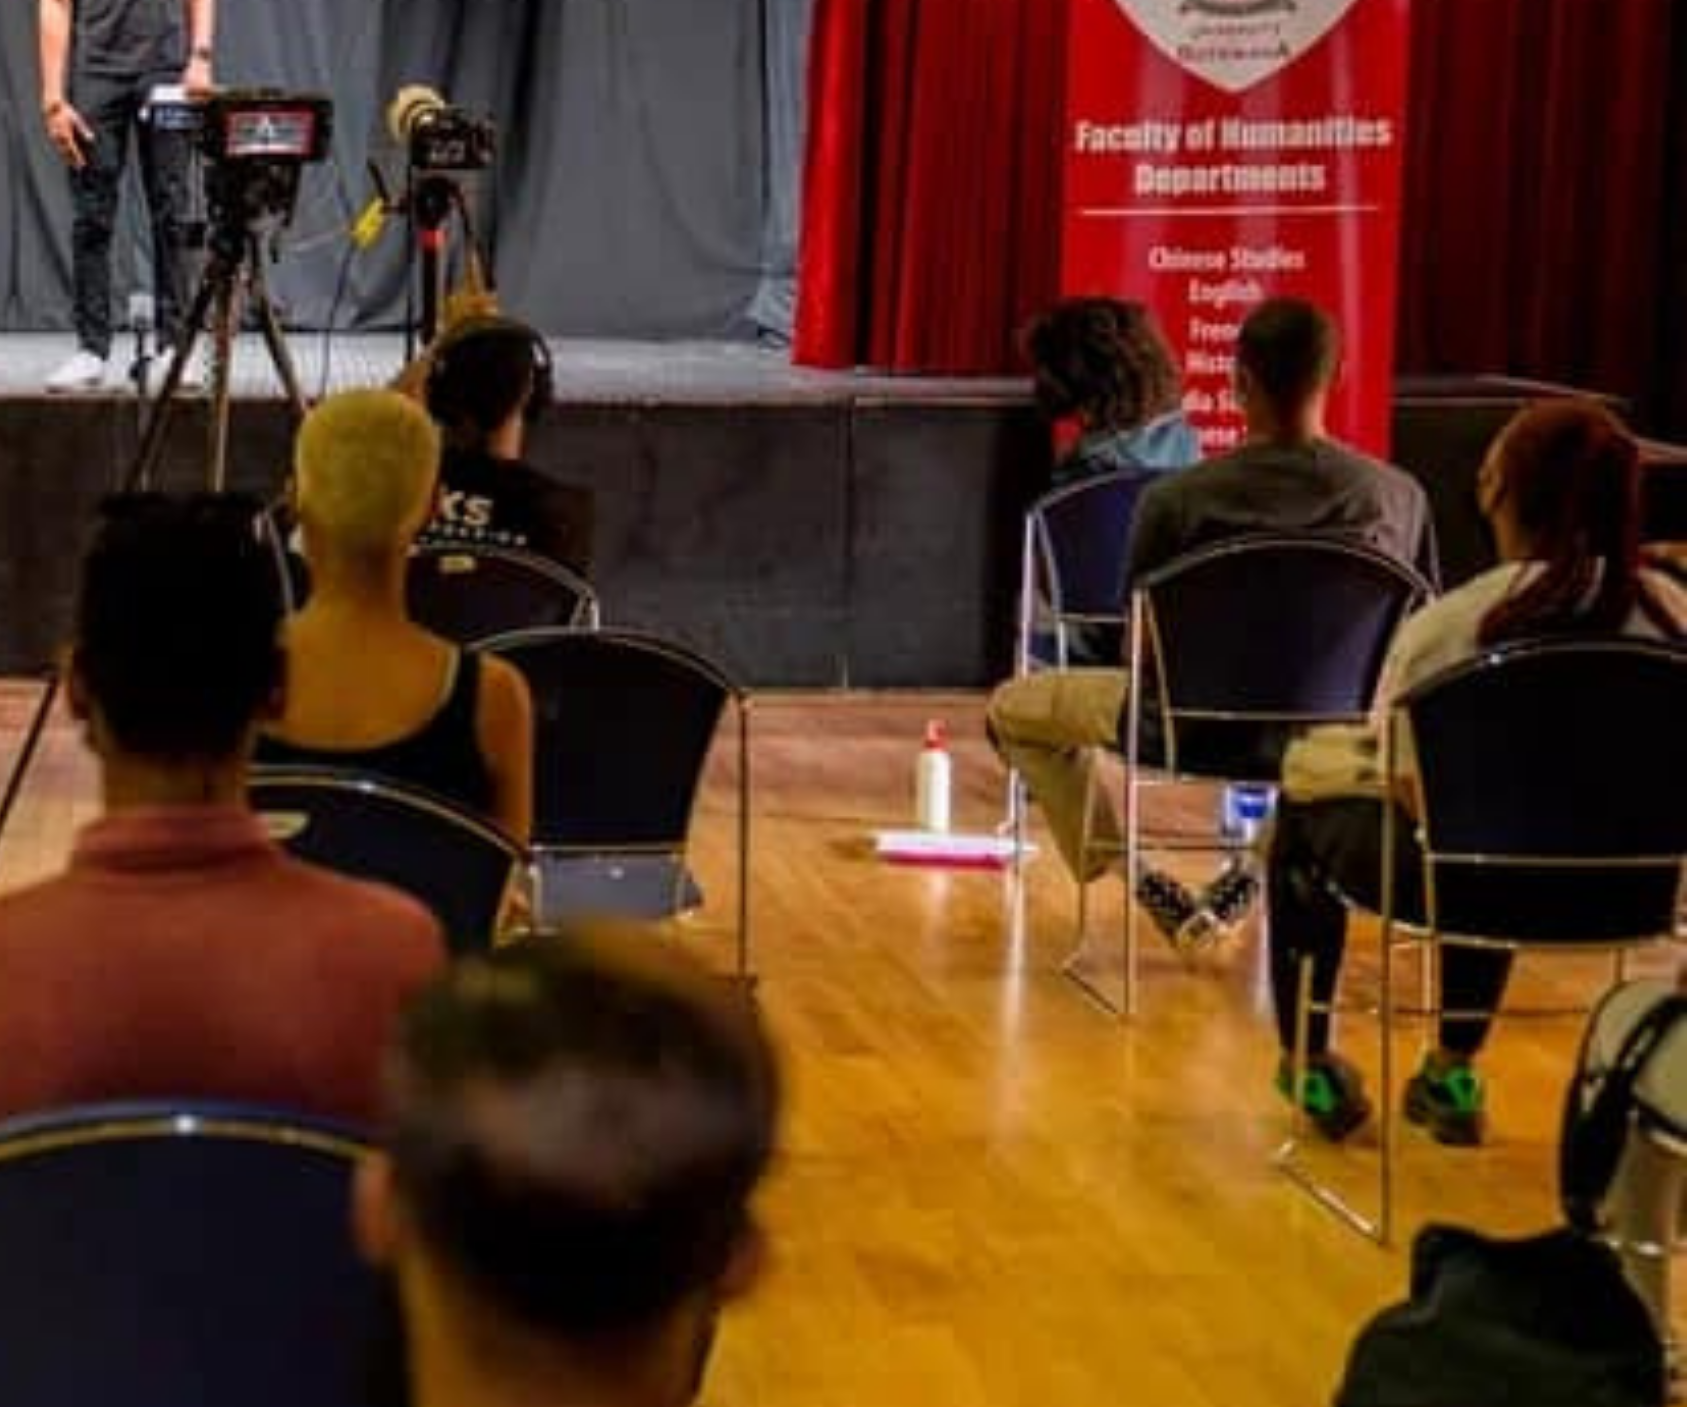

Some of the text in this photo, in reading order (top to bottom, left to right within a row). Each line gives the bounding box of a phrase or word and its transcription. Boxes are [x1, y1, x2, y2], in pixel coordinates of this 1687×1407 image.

[1076, 113, 1393, 153] Faculty of Humanities
[1134, 162, 1326, 196] Departments
[1148, 244, 1306, 271] Chinese Studies
[1187, 277, 1262, 309] English
[1187, 316, 1243, 343] Fren
